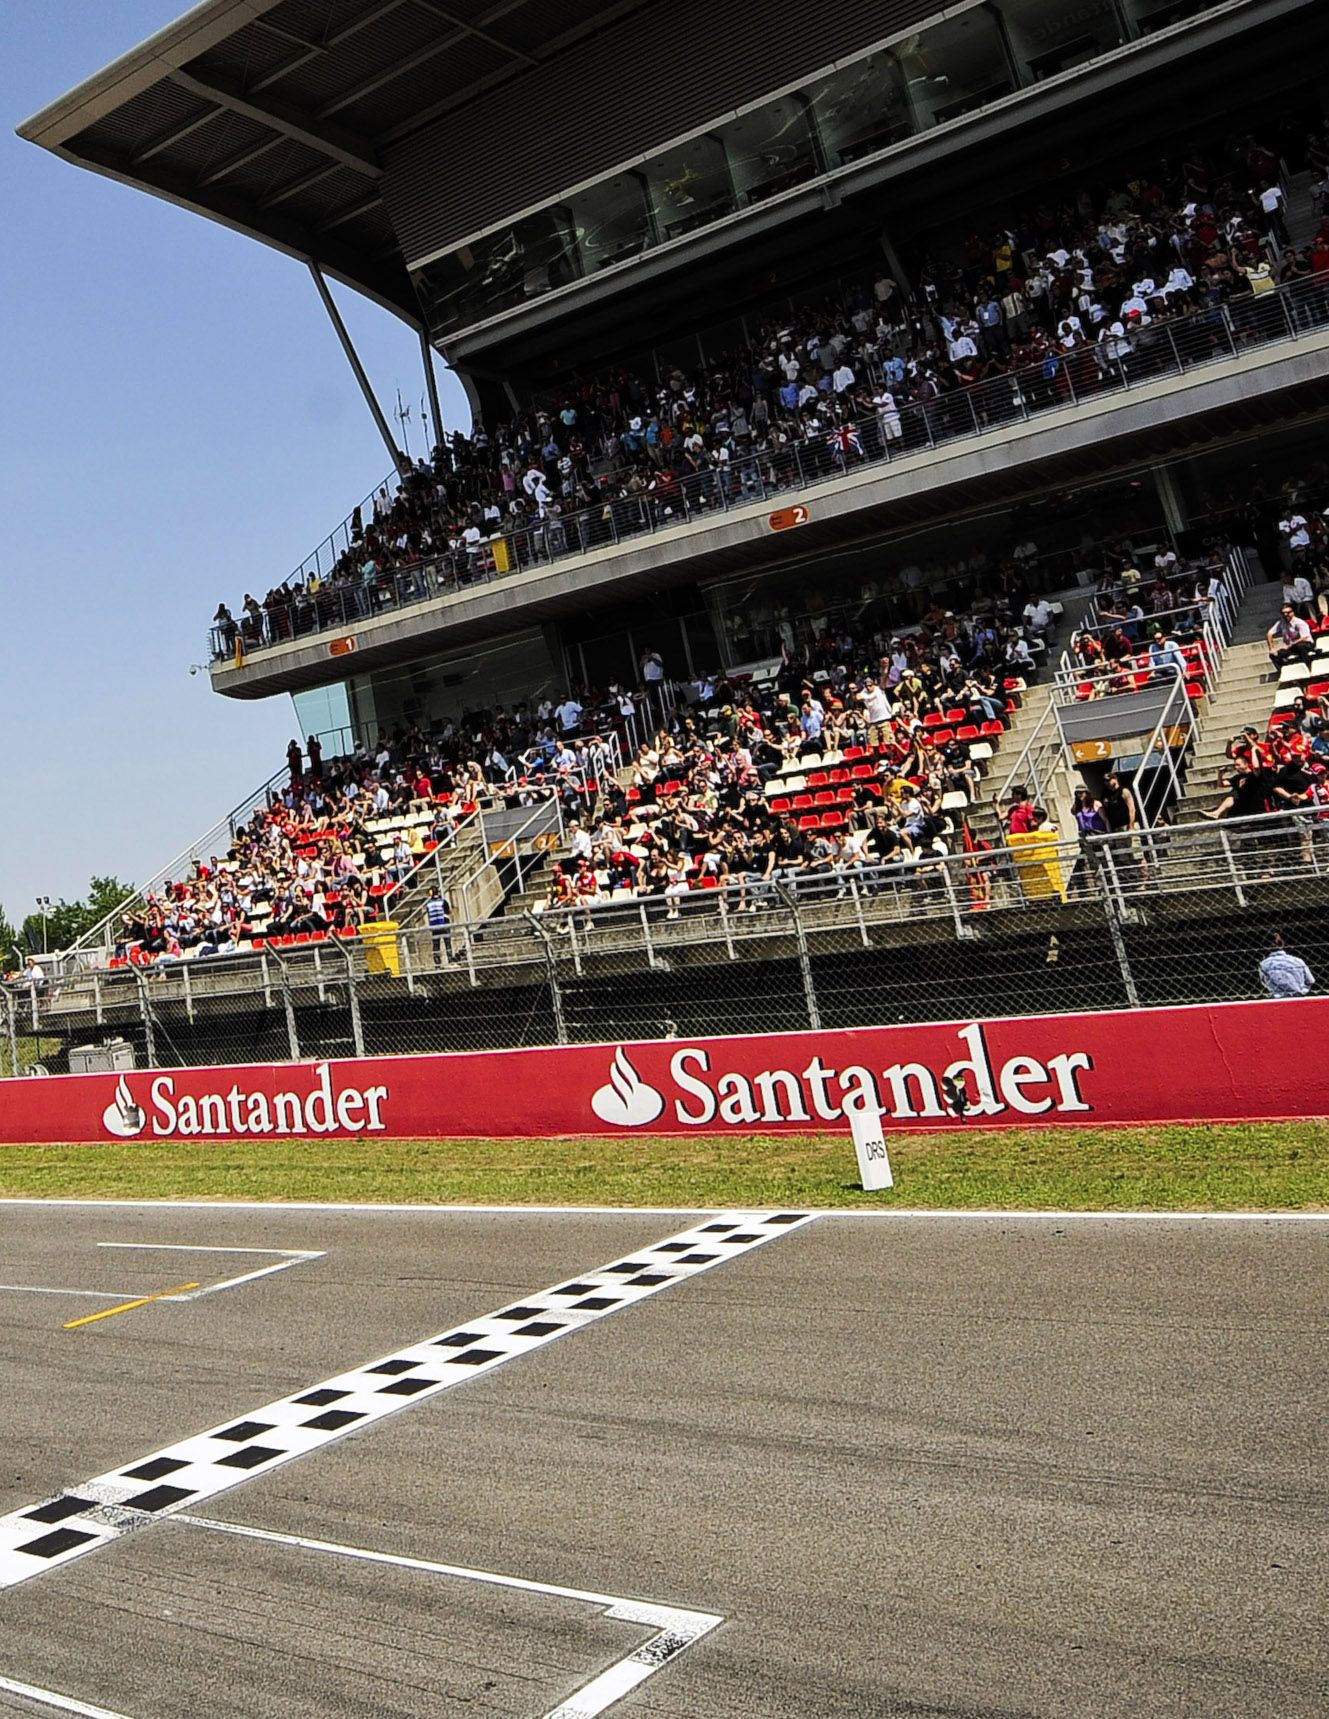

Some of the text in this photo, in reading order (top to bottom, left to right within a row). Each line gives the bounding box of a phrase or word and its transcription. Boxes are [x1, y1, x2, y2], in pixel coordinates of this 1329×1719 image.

[793, 507, 806, 523] 2
[345, 639, 353, 651] 1
[1095, 742, 1107, 755] 2
[670, 1023, 1093, 1125] Santander
[151, 1063, 388, 1135] Santander
[865, 1140, 886, 1161] DRS
